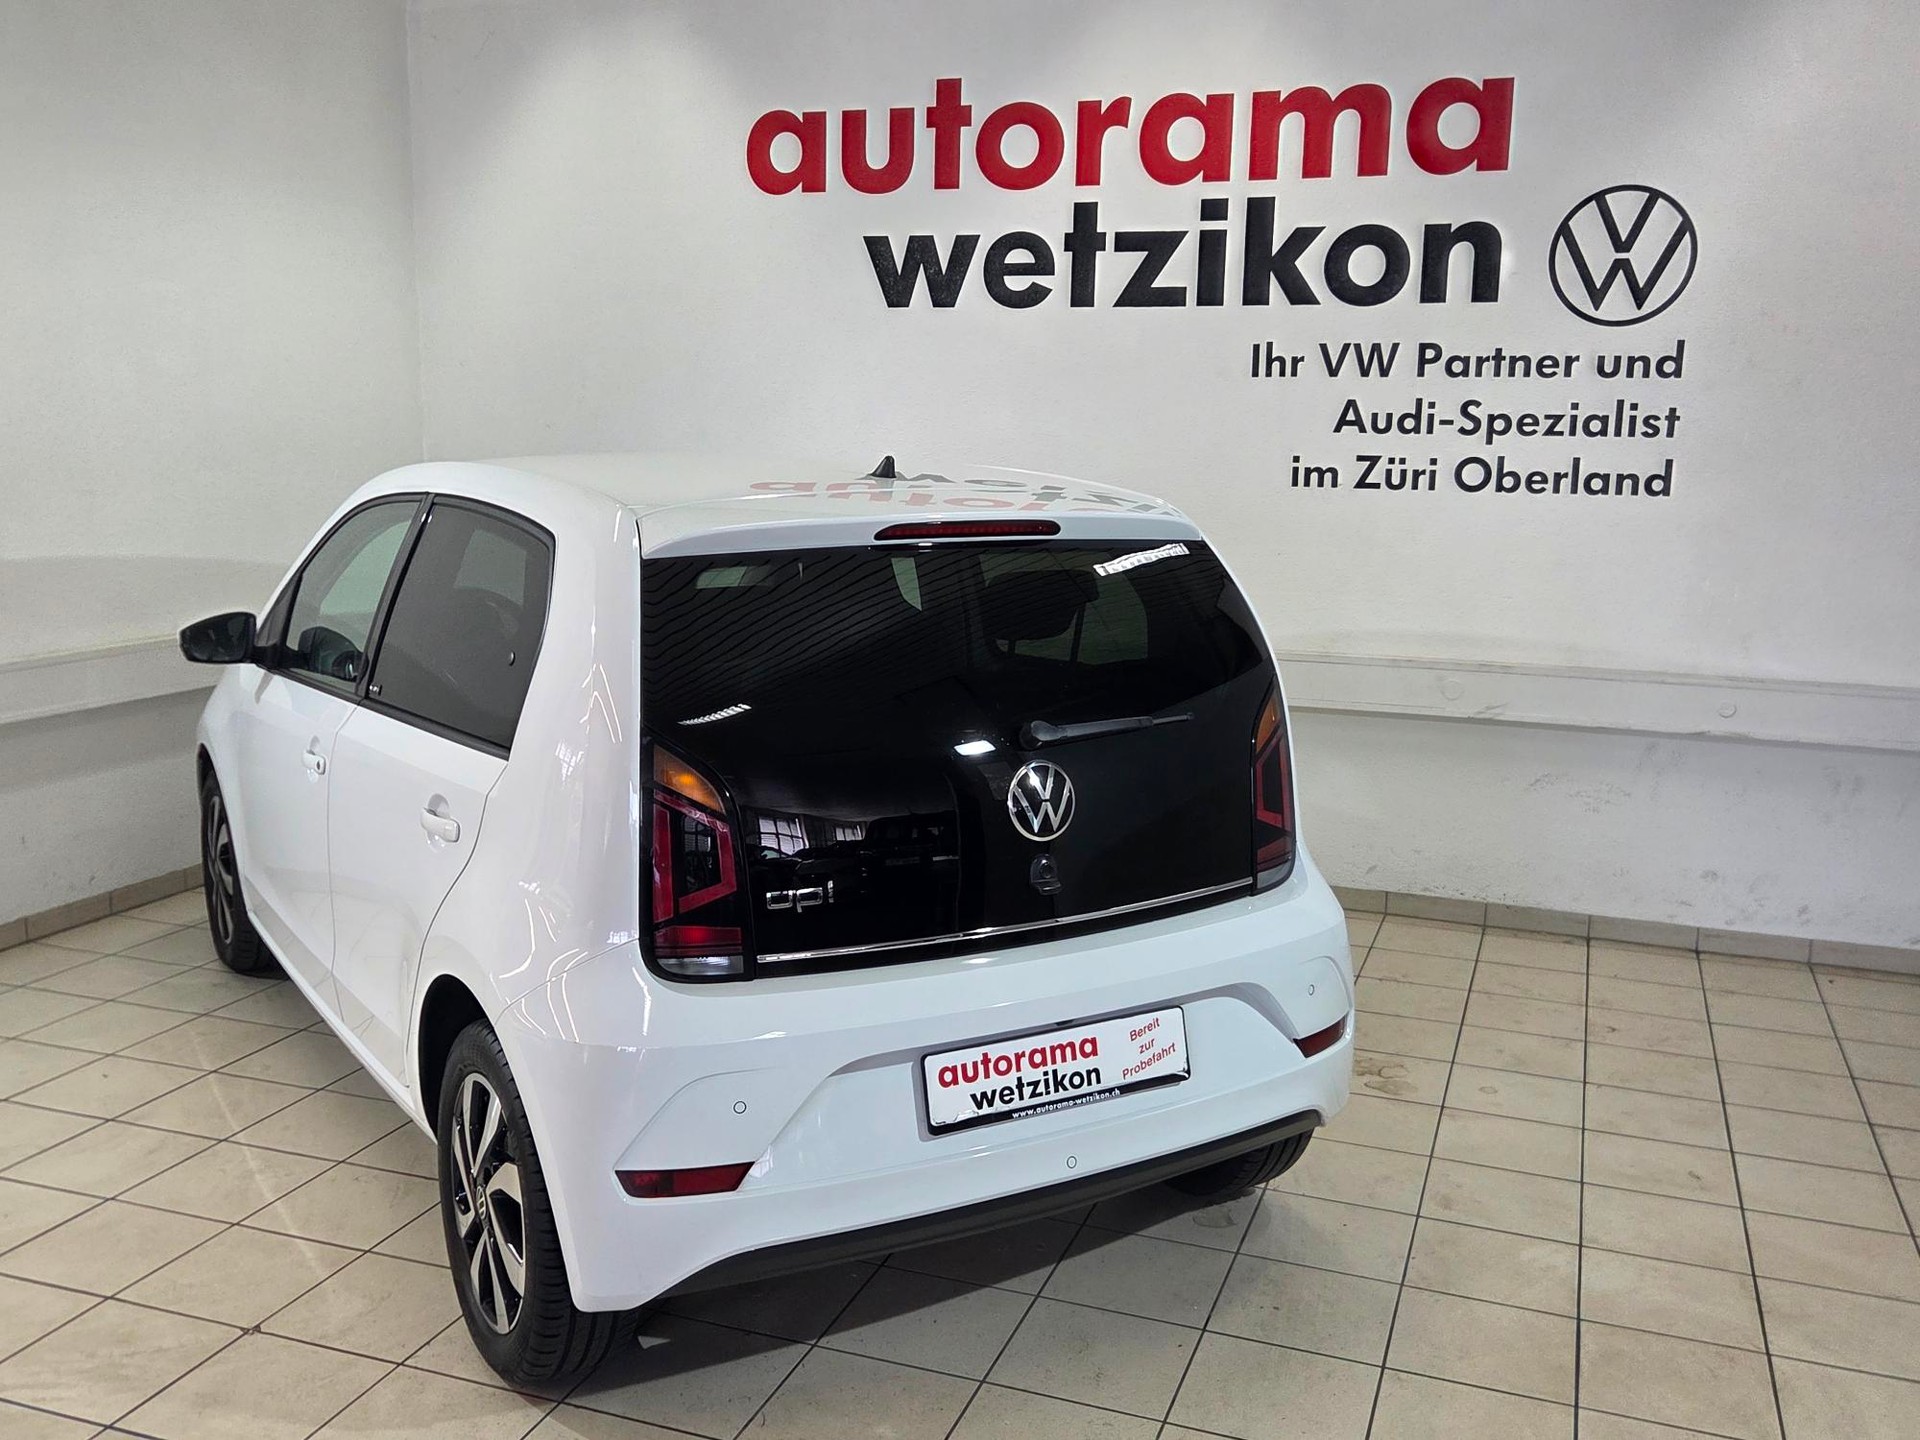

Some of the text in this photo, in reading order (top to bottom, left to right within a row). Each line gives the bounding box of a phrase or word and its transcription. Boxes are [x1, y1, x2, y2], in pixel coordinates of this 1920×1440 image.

[747, 78, 1514, 195] autorama
[864, 197, 1503, 309] wetzikon
[1251, 340, 1686, 379] Ihr VW Partner und
[1333, 398, 1681, 445] Audi-Spezialist
[1291, 455, 1674, 497] im Züri Oberland
[766, 880, 834, 913] up!
[1129, 1017, 1160, 1041] Bereit
[1138, 1038, 1155, 1054] zur
[938, 1036, 1099, 1089] autorama
[1122, 1042, 1176, 1080] Probefahrt
[969, 1066, 1102, 1110] wetzikon
[1012, 1088, 1121, 1118] www.autorama-wetzikon.ch
